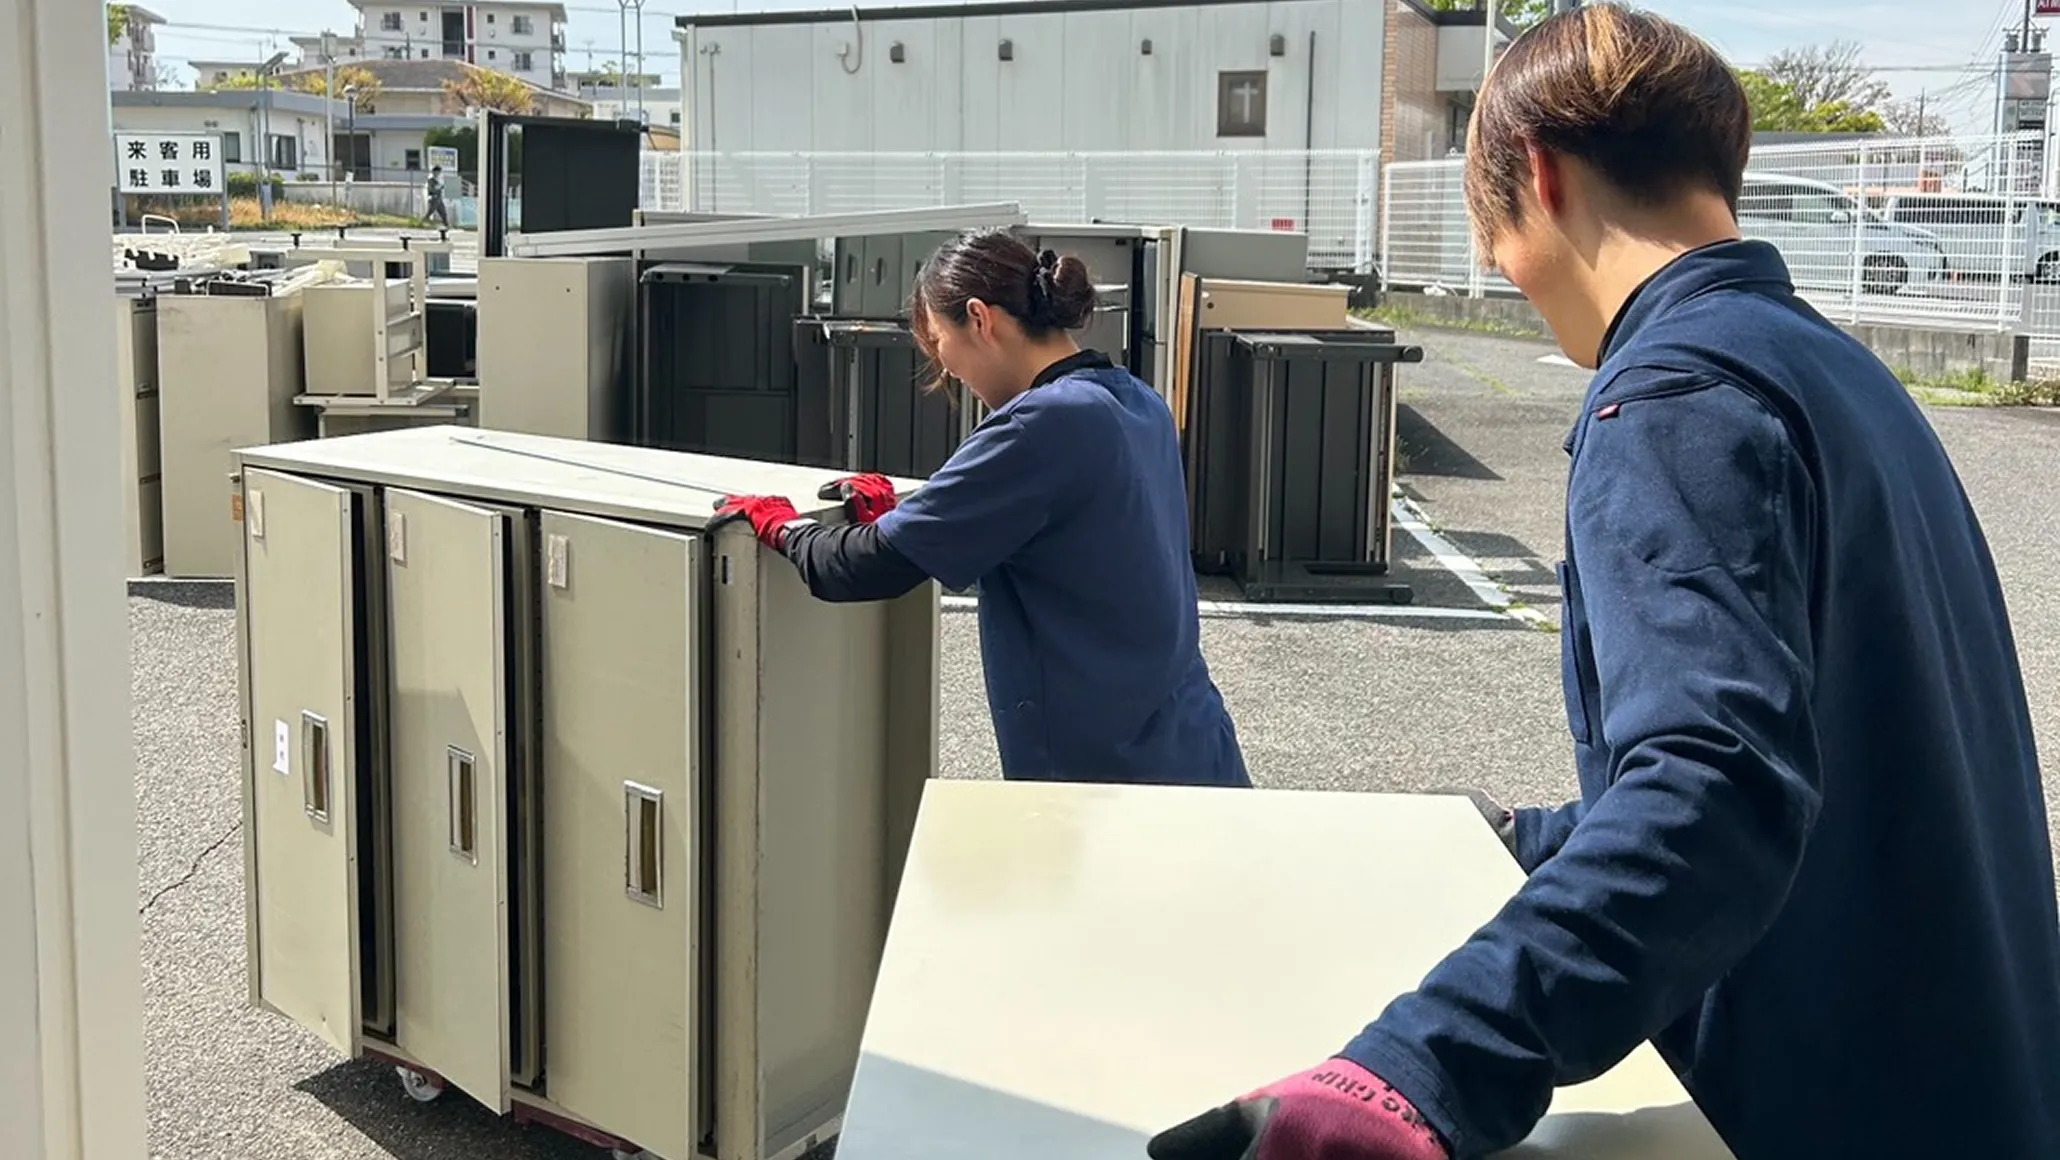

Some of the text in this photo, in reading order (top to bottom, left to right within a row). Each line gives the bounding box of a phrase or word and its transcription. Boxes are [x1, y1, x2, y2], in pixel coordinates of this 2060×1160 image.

[128, 140, 210, 160] 来客用
[129, 168, 211, 188] 駐車場
